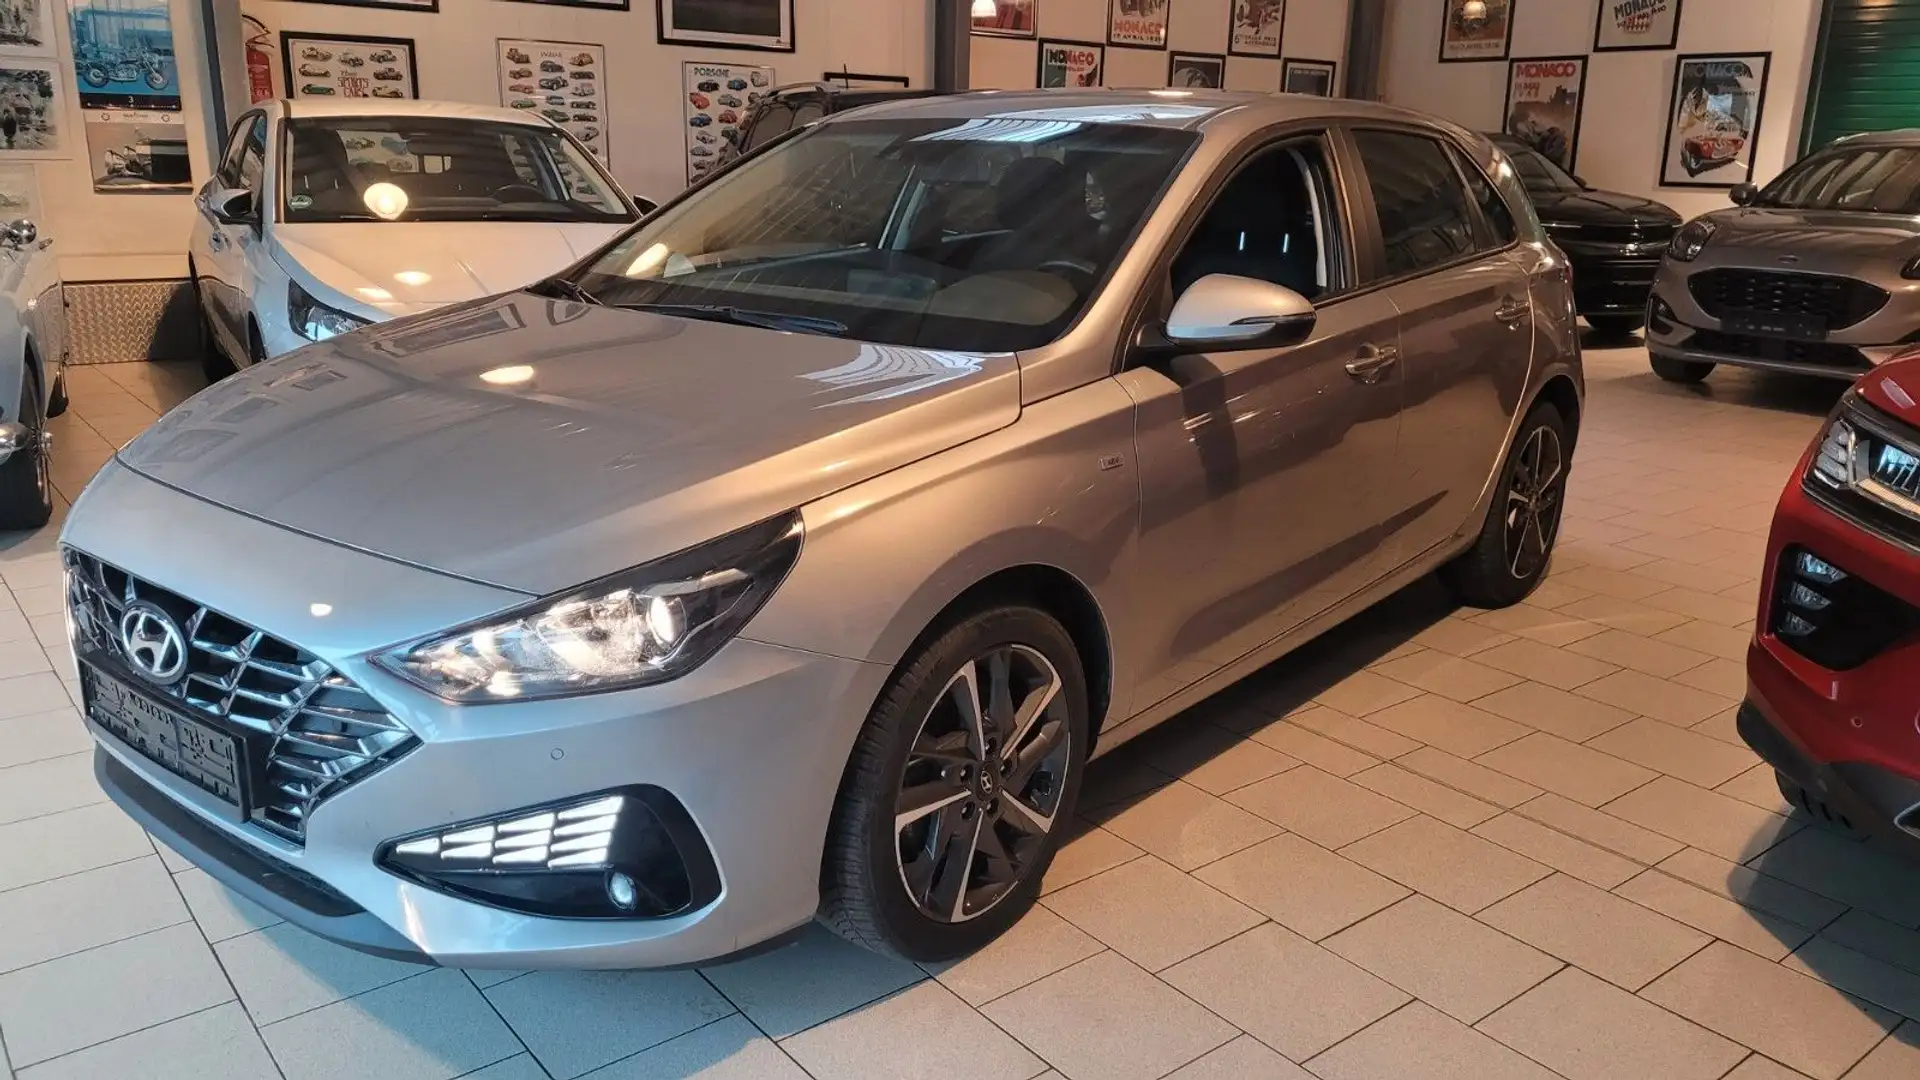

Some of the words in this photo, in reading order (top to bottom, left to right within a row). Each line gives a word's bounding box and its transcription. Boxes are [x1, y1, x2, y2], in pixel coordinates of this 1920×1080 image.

[1613, 0, 1665, 20] MONAC
[1114, 20, 1164, 35] MONACO
[1047, 49, 1095, 66] MONACO
[694, 67, 729, 78] PORSCHE
[1515, 62, 1576, 79] MONACO
[338, 76, 369, 89] SPORTS
